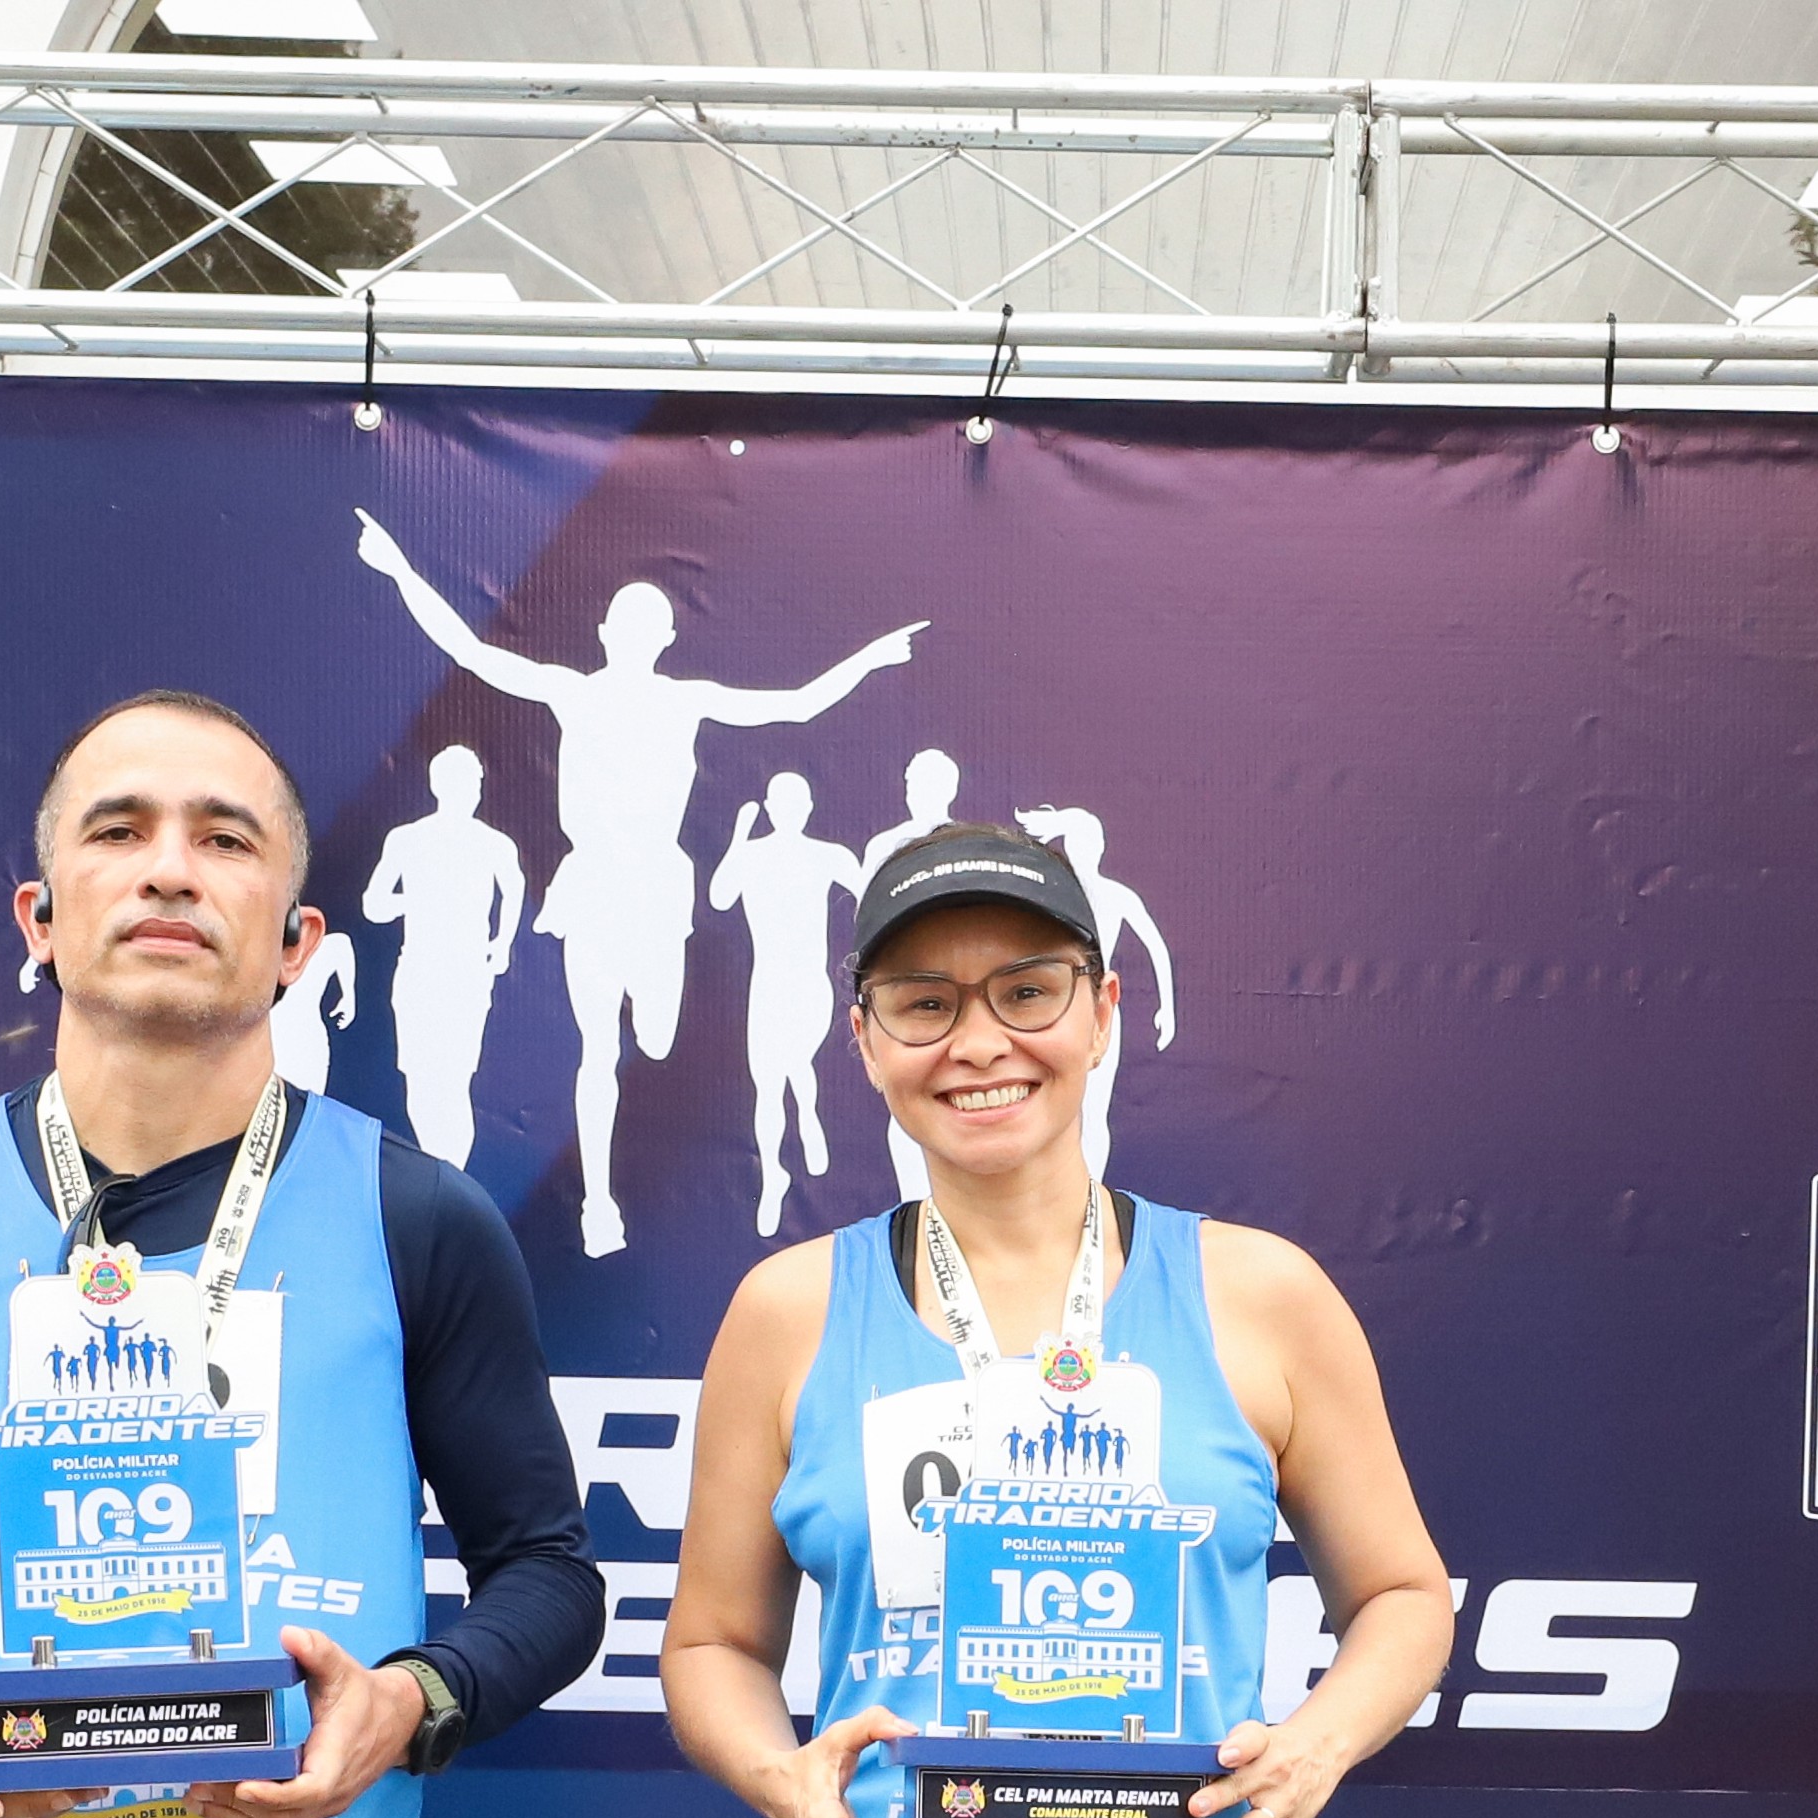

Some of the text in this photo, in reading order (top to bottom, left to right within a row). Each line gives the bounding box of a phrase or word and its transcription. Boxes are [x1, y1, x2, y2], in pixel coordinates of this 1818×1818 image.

[14, 1393, 218, 1424] CORRIDA
[52, 1453, 180, 1472] POLÍCIA MILITAR
[82, 1471, 122, 1481] ESTADO
[123, 1471, 140, 1480] DO
[141, 1469, 168, 1479] ACRE
[968, 1479, 1166, 1508] CORRIDA
[43, 1482, 194, 1548] 109
[103, 1508, 136, 1520] anos
[925, 1501, 1212, 1534] TIRADENTES
[1002, 1536, 1126, 1555] POLÍCIA MILITAR
[1014, 1553, 1114, 1564] DO ESTADO DO ACRE
[91, 1607, 104, 1617] DE
[106, 1602, 131, 1615] MAIO
[132, 1599, 146, 1609] DE
[990, 1568, 1135, 1630] 109
[1028, 1686, 1041, 1696] DE
[1042, 1684, 1068, 1696] MAIO
[1069, 1682, 1083, 1692] DE
[75, 1702, 222, 1725] POLÍCIA MILITAR
[61, 1724, 238, 1748] DO ESTADO DO ACRE
[993, 1786, 1181, 1807] CEL PM MARTA RENATA
